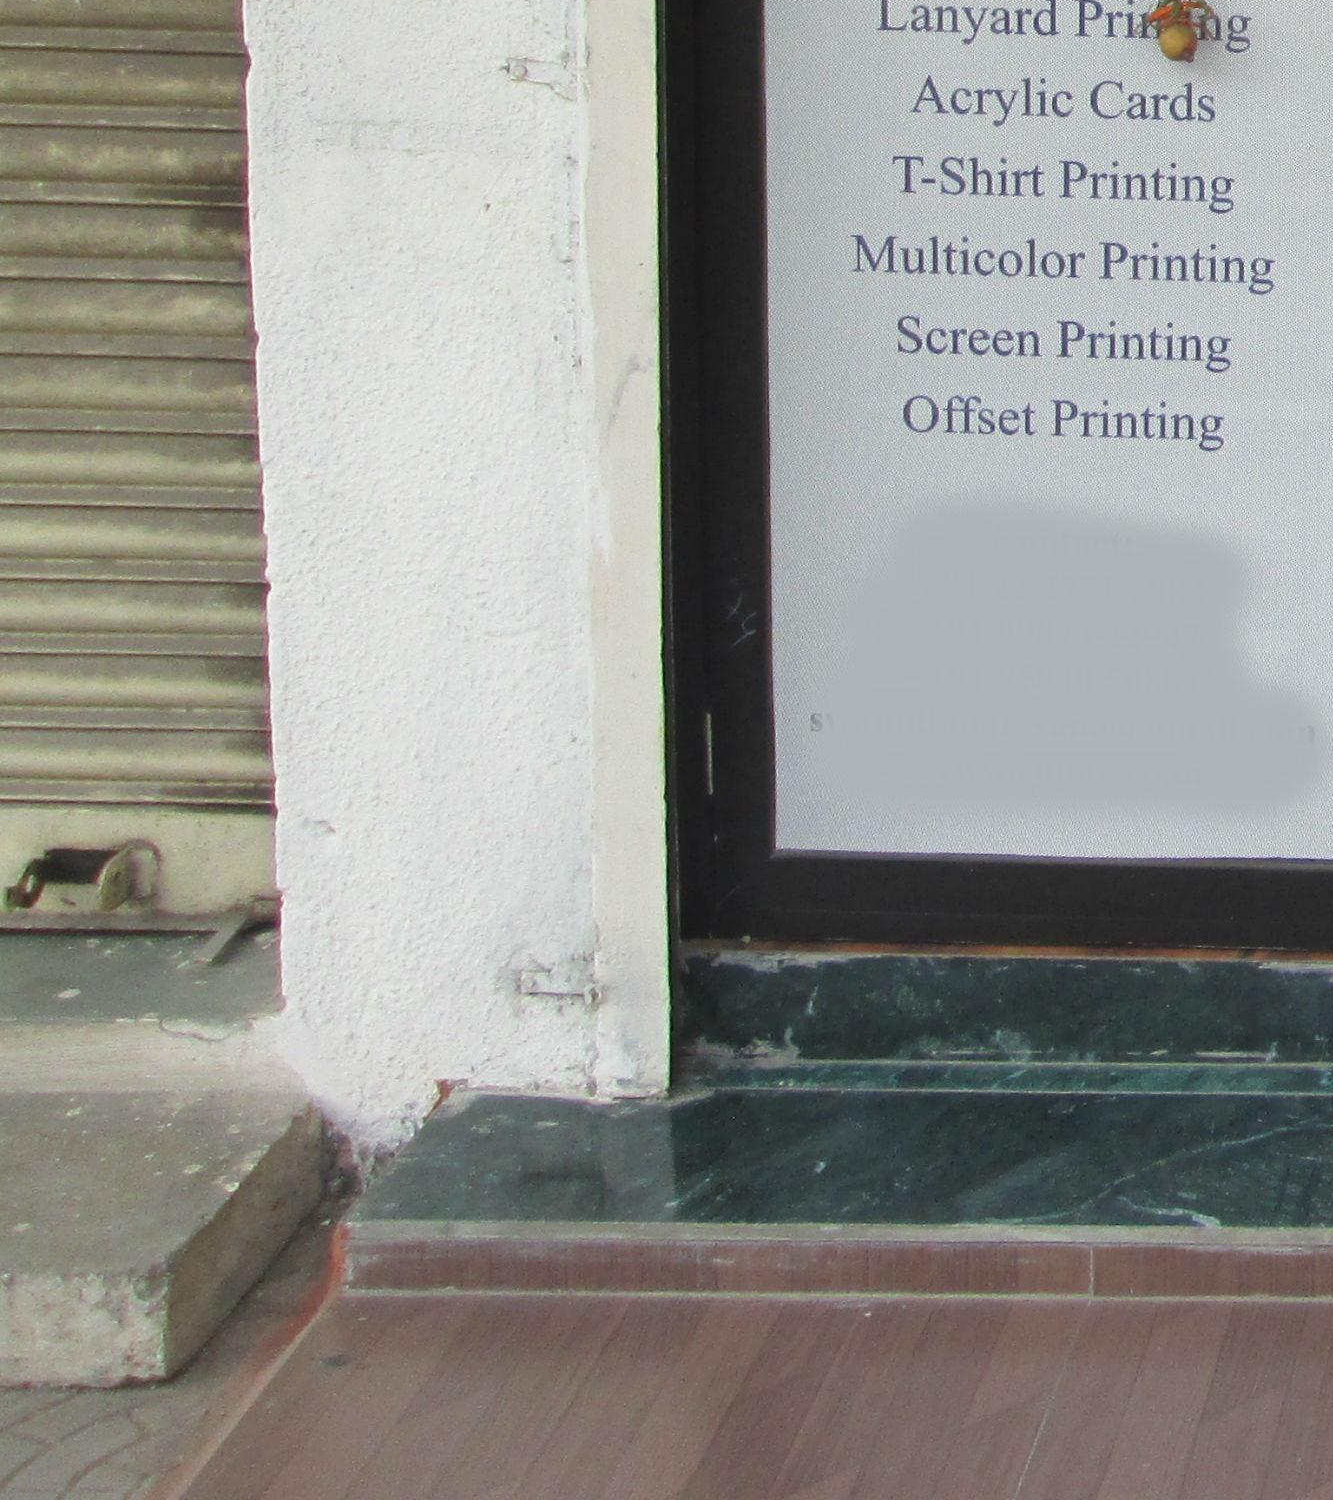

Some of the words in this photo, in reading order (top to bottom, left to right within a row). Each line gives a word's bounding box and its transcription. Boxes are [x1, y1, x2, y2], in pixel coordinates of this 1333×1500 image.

[911, 74, 1074, 127] Acrylic
[1089, 79, 1216, 122] Cards
[892, 155, 1045, 198] T-Shirt
[1059, 159, 1235, 214] Printing
[851, 233, 1086, 279] Multicolor
[1099, 240, 1276, 295] Printing
[896, 314, 1043, 357] Screen
[1056, 319, 1232, 373] Printing
[902, 394, 1036, 436] Offset
[1050, 398, 1225, 451] Printing
